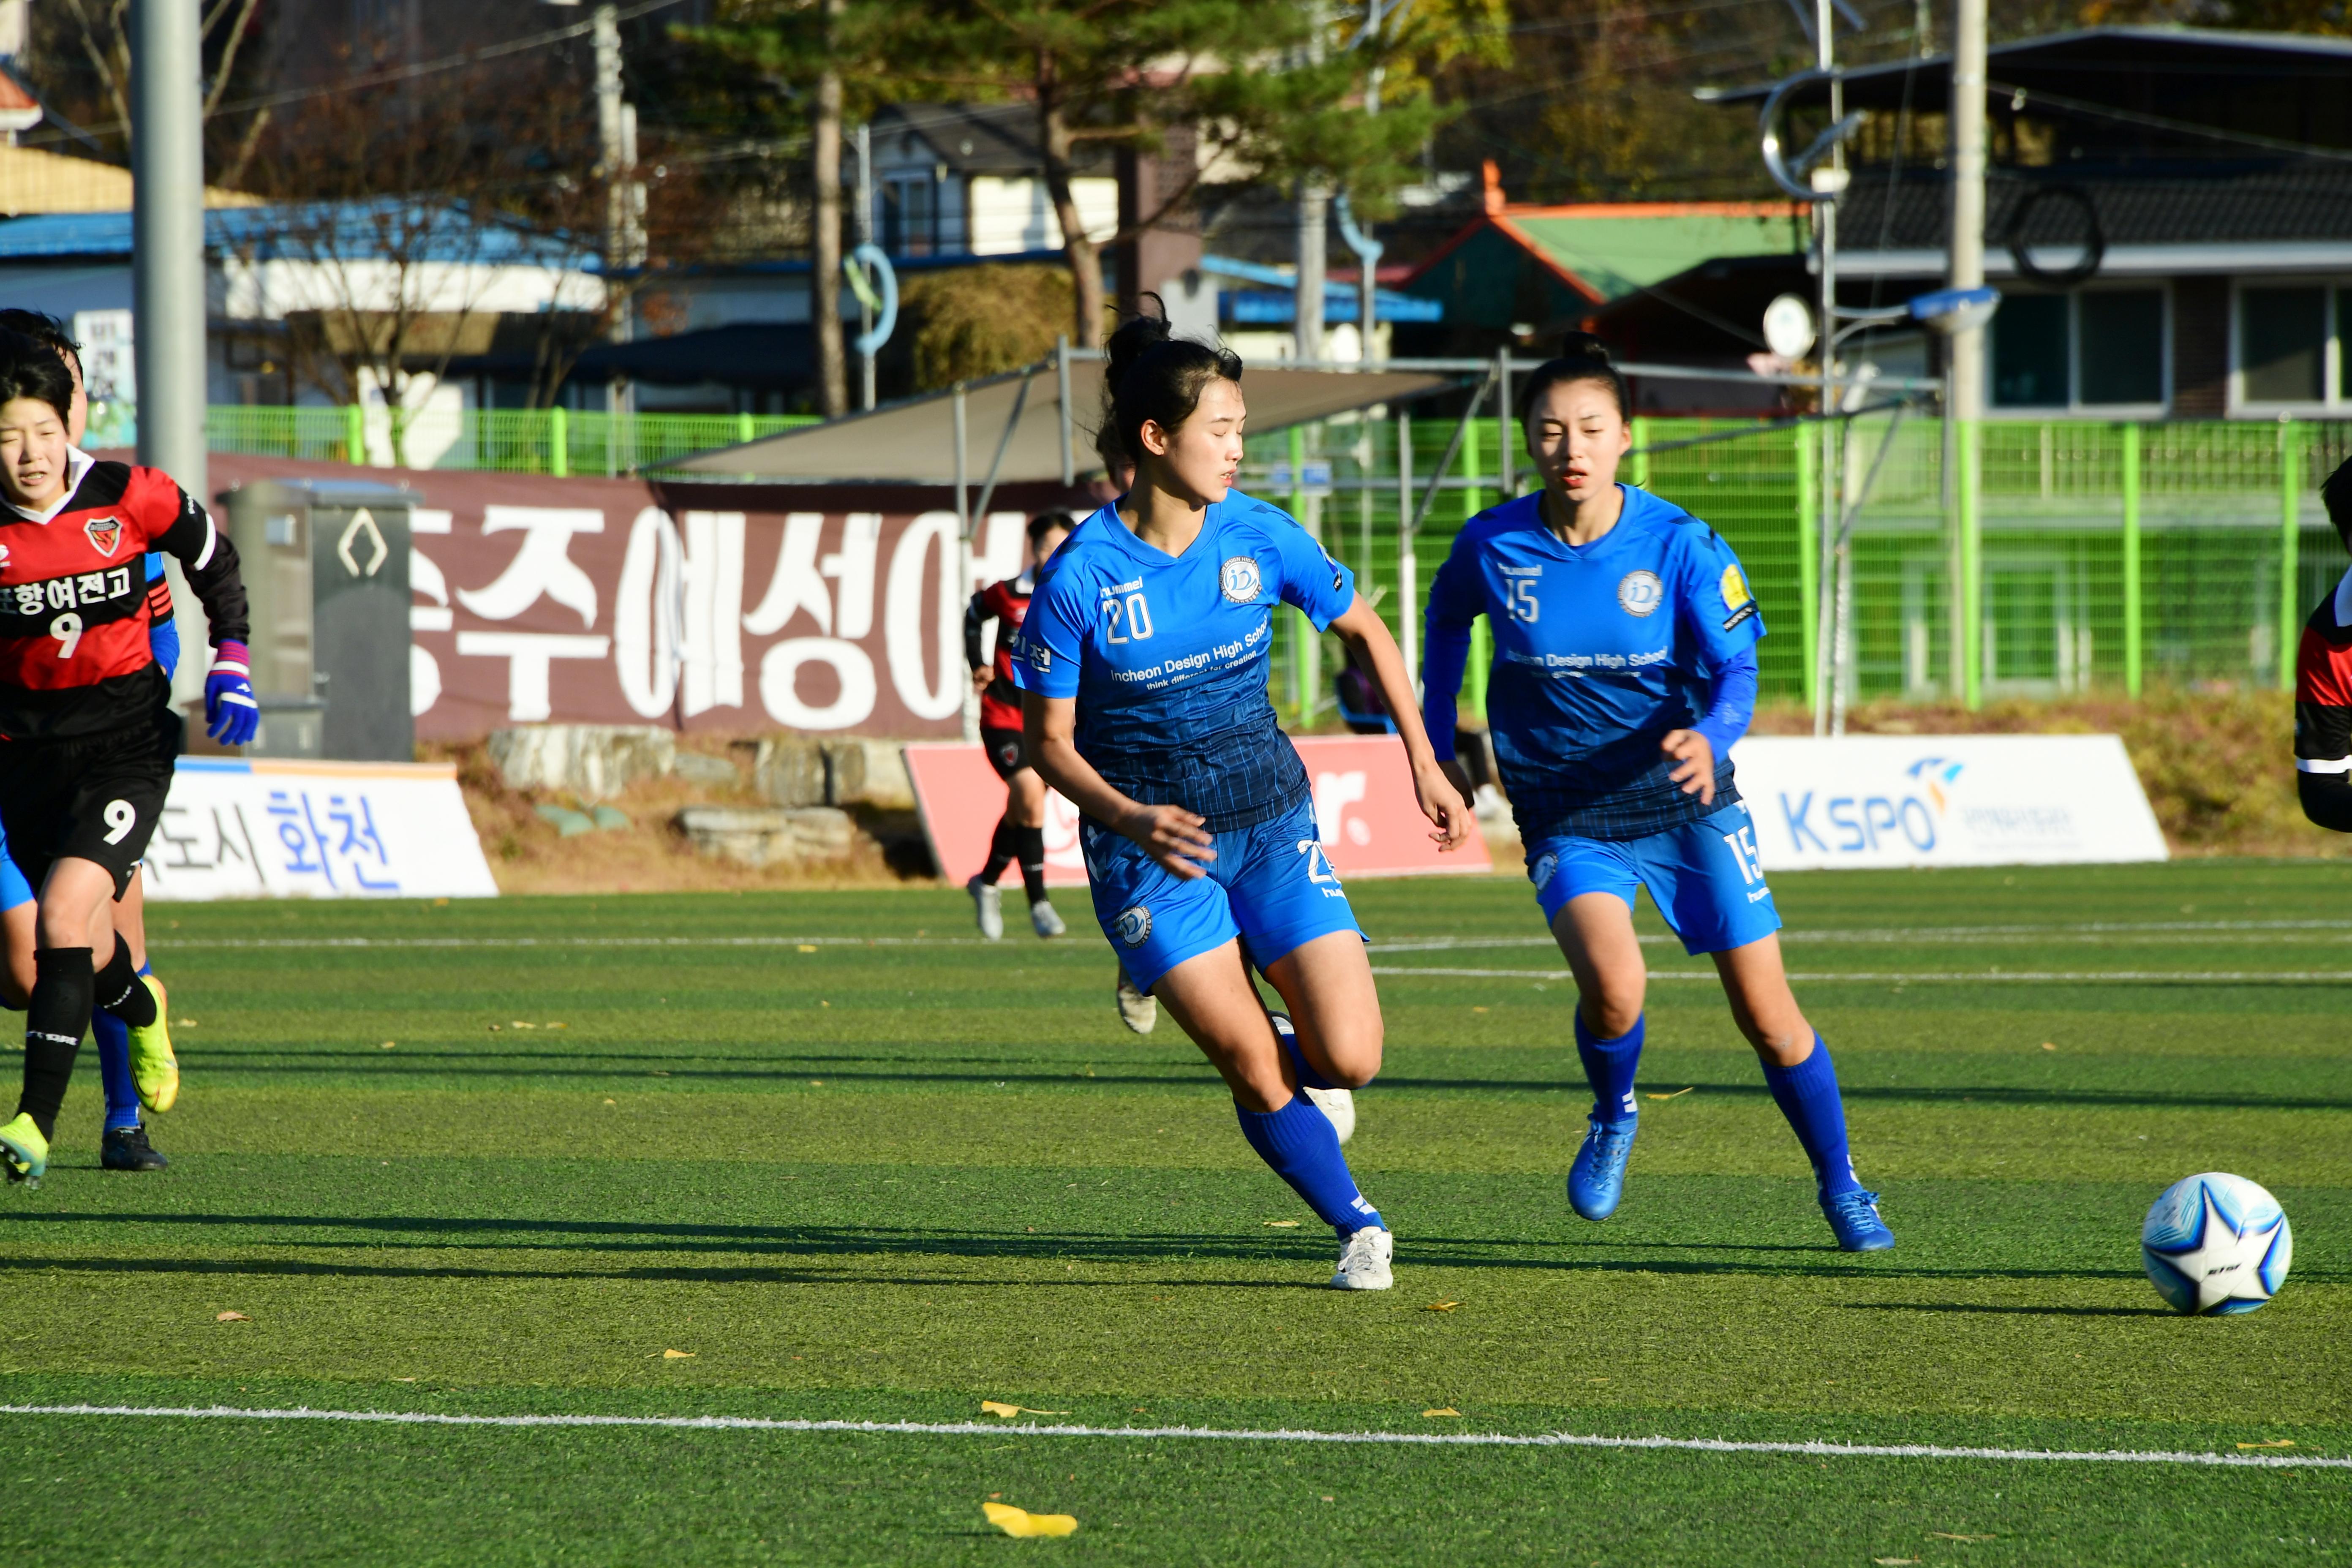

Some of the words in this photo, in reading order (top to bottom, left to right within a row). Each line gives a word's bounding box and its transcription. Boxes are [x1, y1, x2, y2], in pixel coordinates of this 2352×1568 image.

[1099, 576, 1143, 598] hummel
[1505, 578, 1539, 623] 15
[49, 612, 83, 659] 9
[1102, 593, 1154, 645] 20
[1111, 665, 1162, 683] Incheon
[1165, 651, 1211, 673] Design
[1213, 640, 1243, 660] High
[1245, 614, 1267, 647] School
[1146, 678, 1169, 691] think
[1225, 650, 1257, 670] creation
[1545, 653, 1593, 669] Design
[1595, 653, 1627, 669] High
[1628, 645, 1669, 666] School
[103, 798, 136, 846] 9
[146, 803, 265, 885] 도시
[266, 791, 400, 890] 화천
[1779, 791, 1936, 852] KSPO
[1723, 825, 1764, 884] 15
